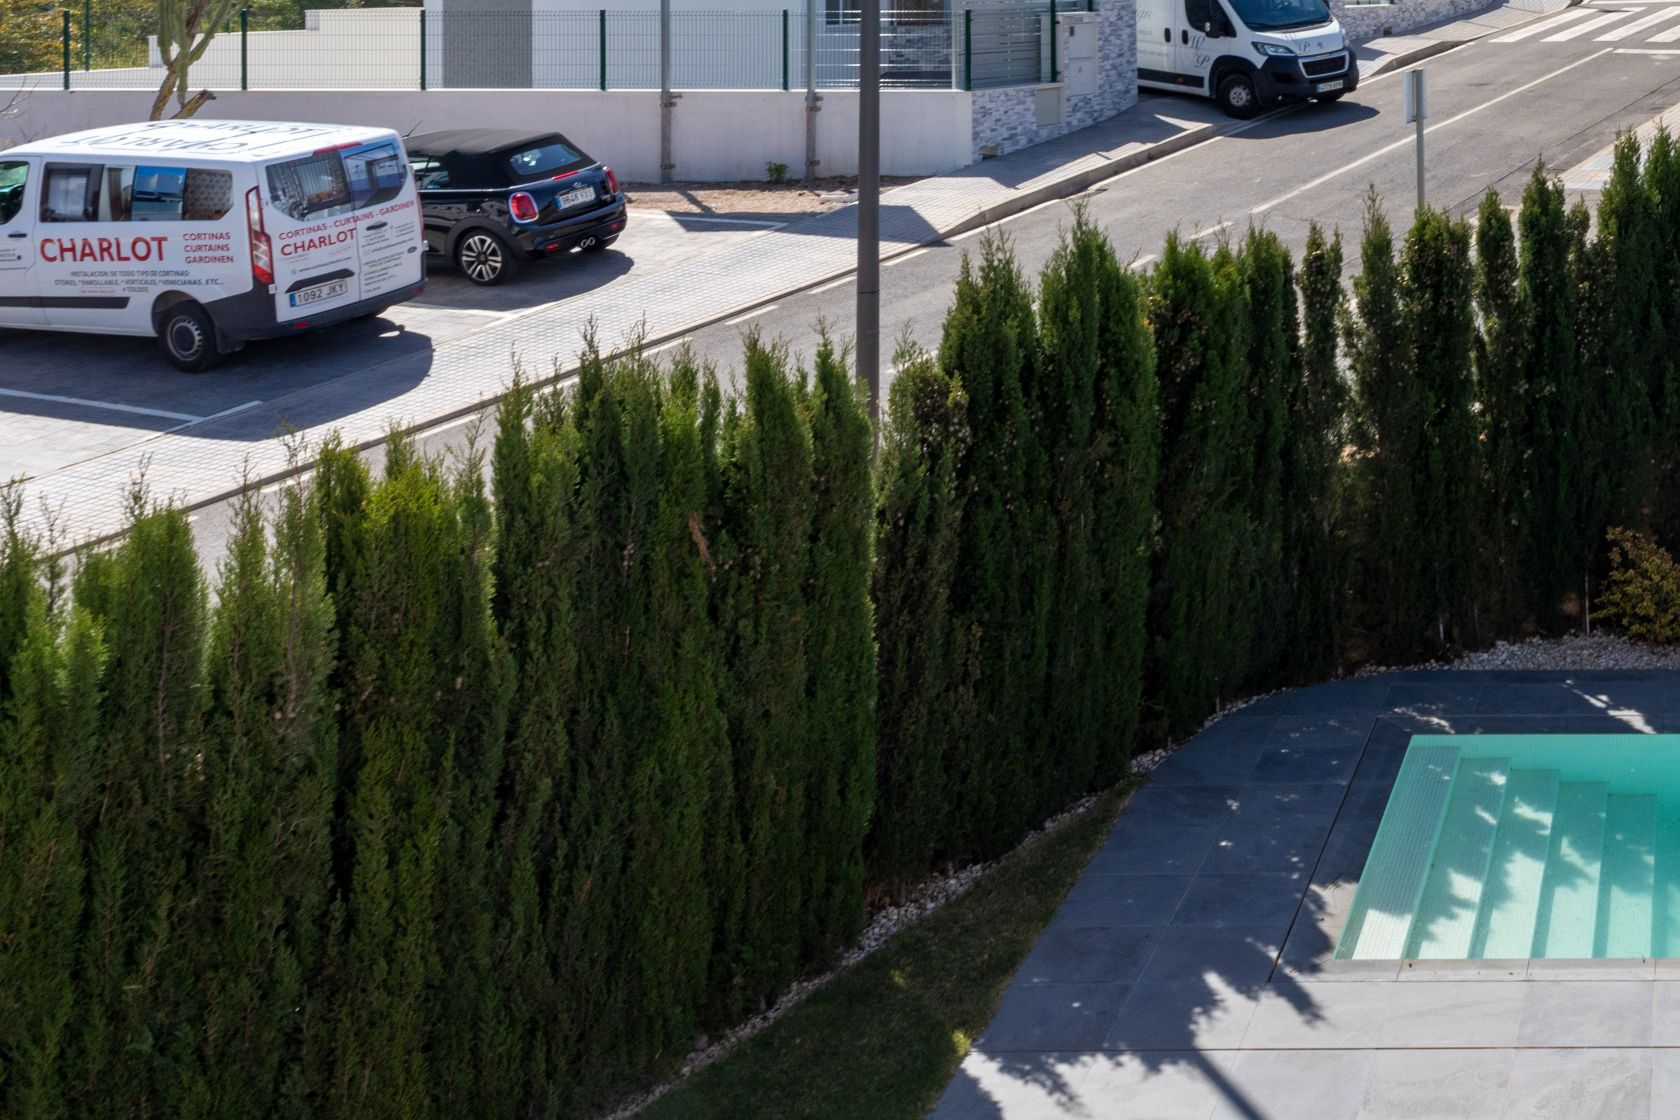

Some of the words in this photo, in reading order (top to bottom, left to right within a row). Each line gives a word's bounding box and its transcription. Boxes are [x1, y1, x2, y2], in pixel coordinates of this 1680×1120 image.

[182, 232, 231, 241] CORTINAS
[279, 224, 328, 241] CORTINAS
[333, 211, 376, 228] CURTAINS
[40, 236, 168, 262] CHARLOT
[183, 244, 230, 253] CURTAINS
[280, 227, 357, 256] CHARLOT
[184, 255, 234, 264] GARDINEN
[297, 288, 322, 304] 1092
[327, 283, 345, 297] JKY
